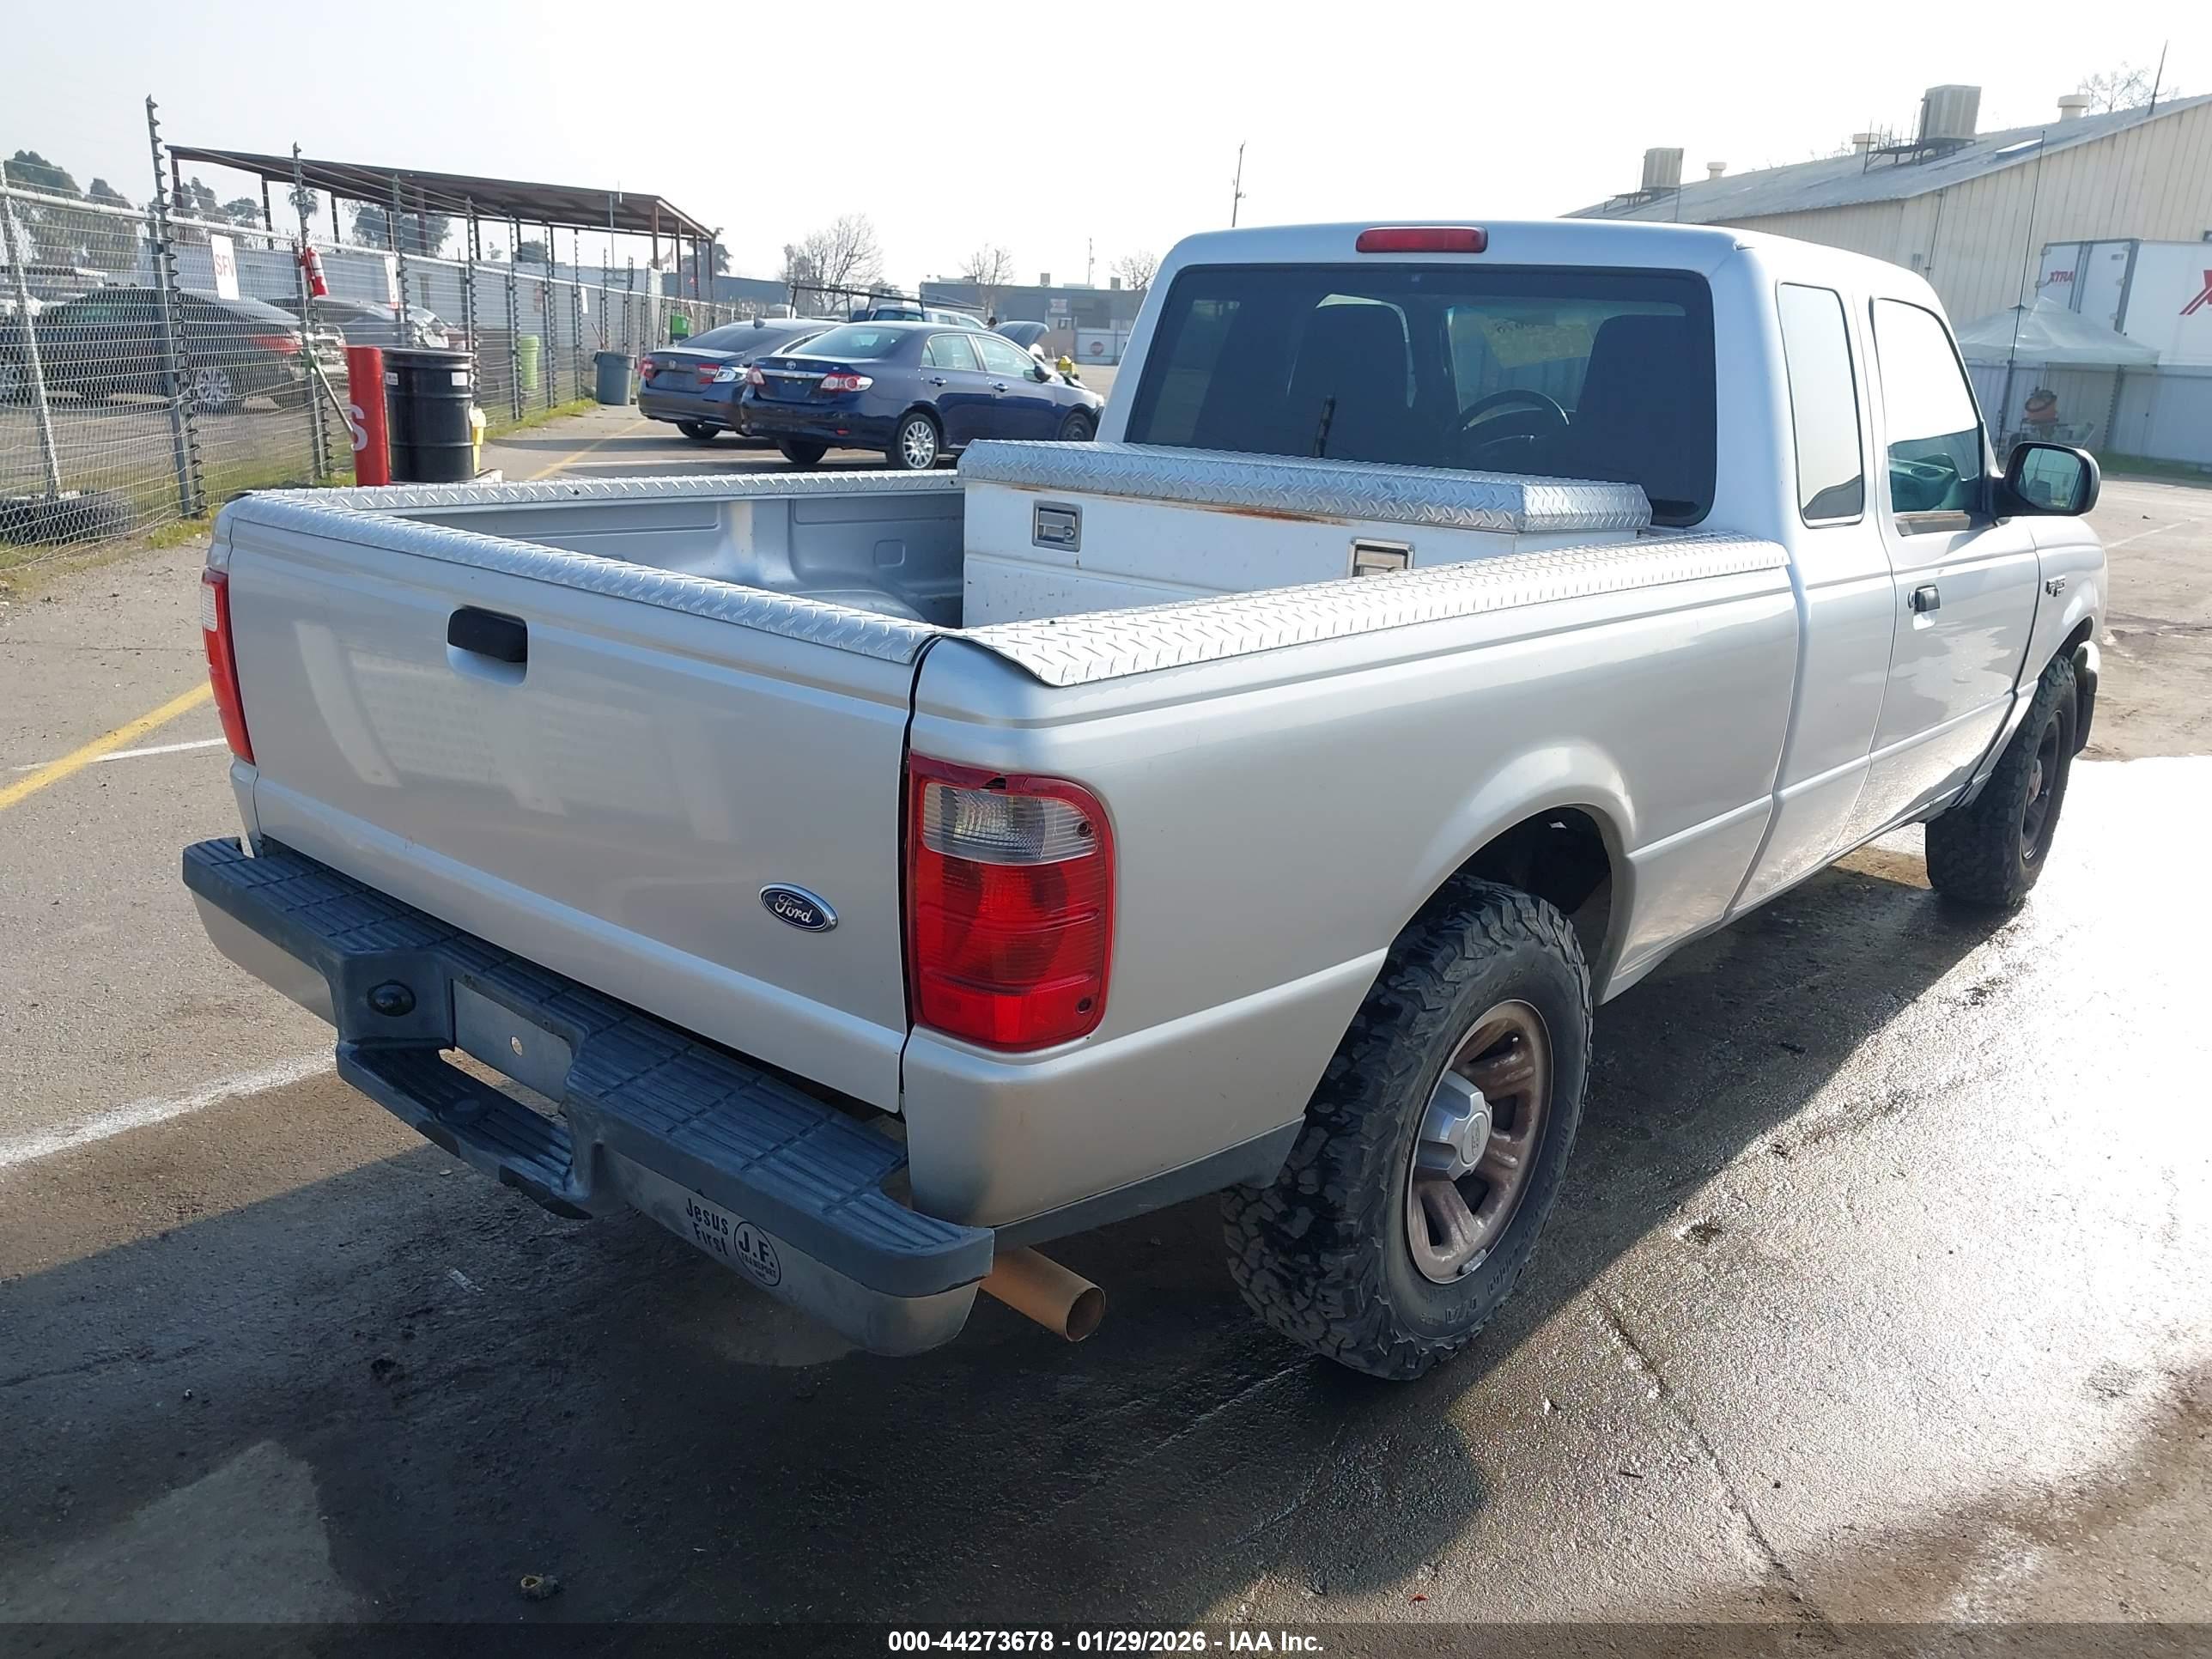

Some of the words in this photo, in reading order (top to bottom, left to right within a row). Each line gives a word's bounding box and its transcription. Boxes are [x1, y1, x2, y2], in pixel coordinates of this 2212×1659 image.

[215, 253, 234, 277] SFV
[775, 893, 813, 923] Ford
[686, 1197, 729, 1237] Jesus
